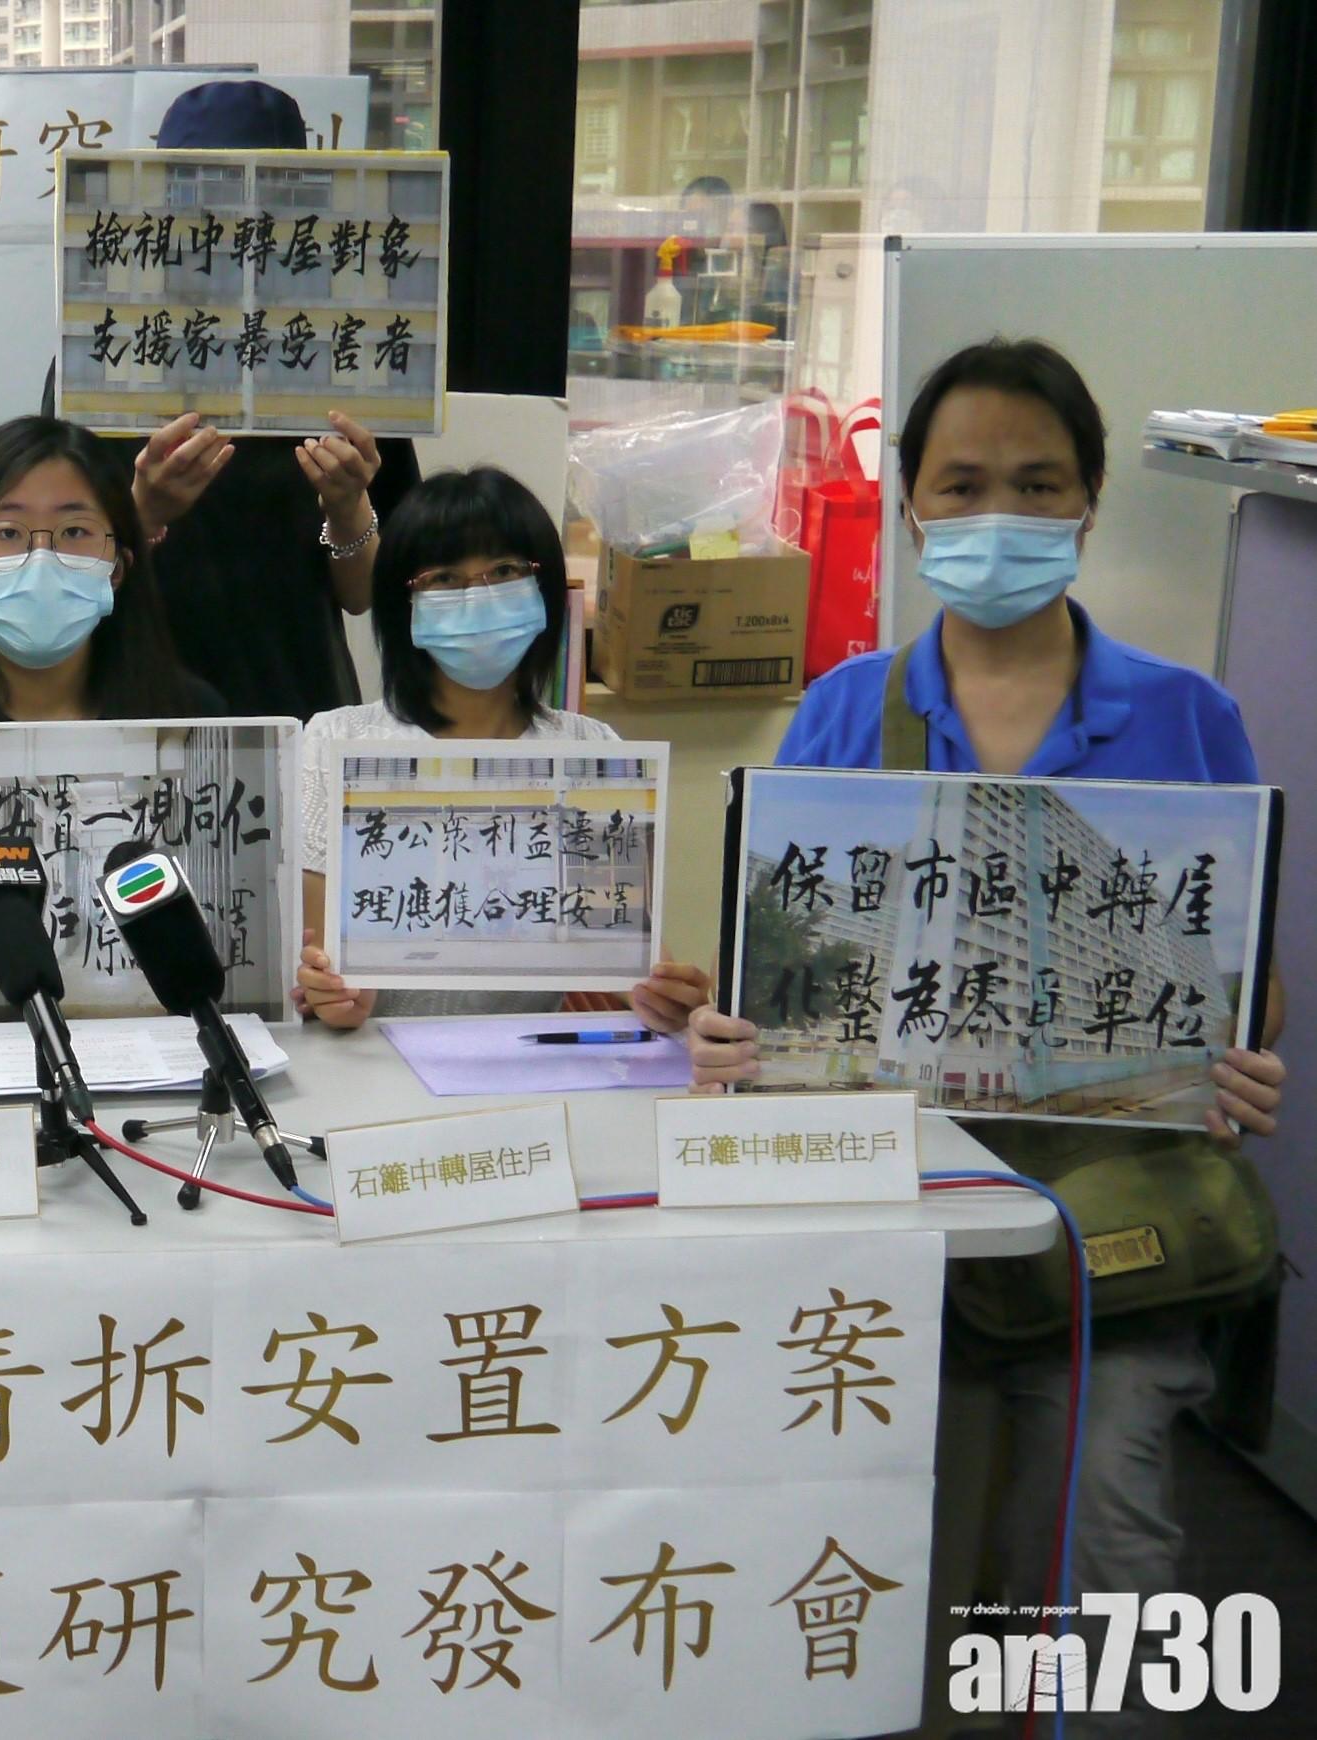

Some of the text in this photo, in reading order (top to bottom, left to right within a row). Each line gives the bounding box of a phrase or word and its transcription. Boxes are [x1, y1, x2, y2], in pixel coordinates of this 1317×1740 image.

[85, 208, 422, 278] 檢視中轉屋對象
[89, 308, 415, 377] 支援家暴受害者
[351, 877, 635, 932] 理應獲合理安置
[770, 839, 1217, 936] 保留市區中轉屋
[349, 1141, 553, 1199] 石籬中轉屋住戶
[675, 1131, 898, 1167] 石籬中轉屋住戶
